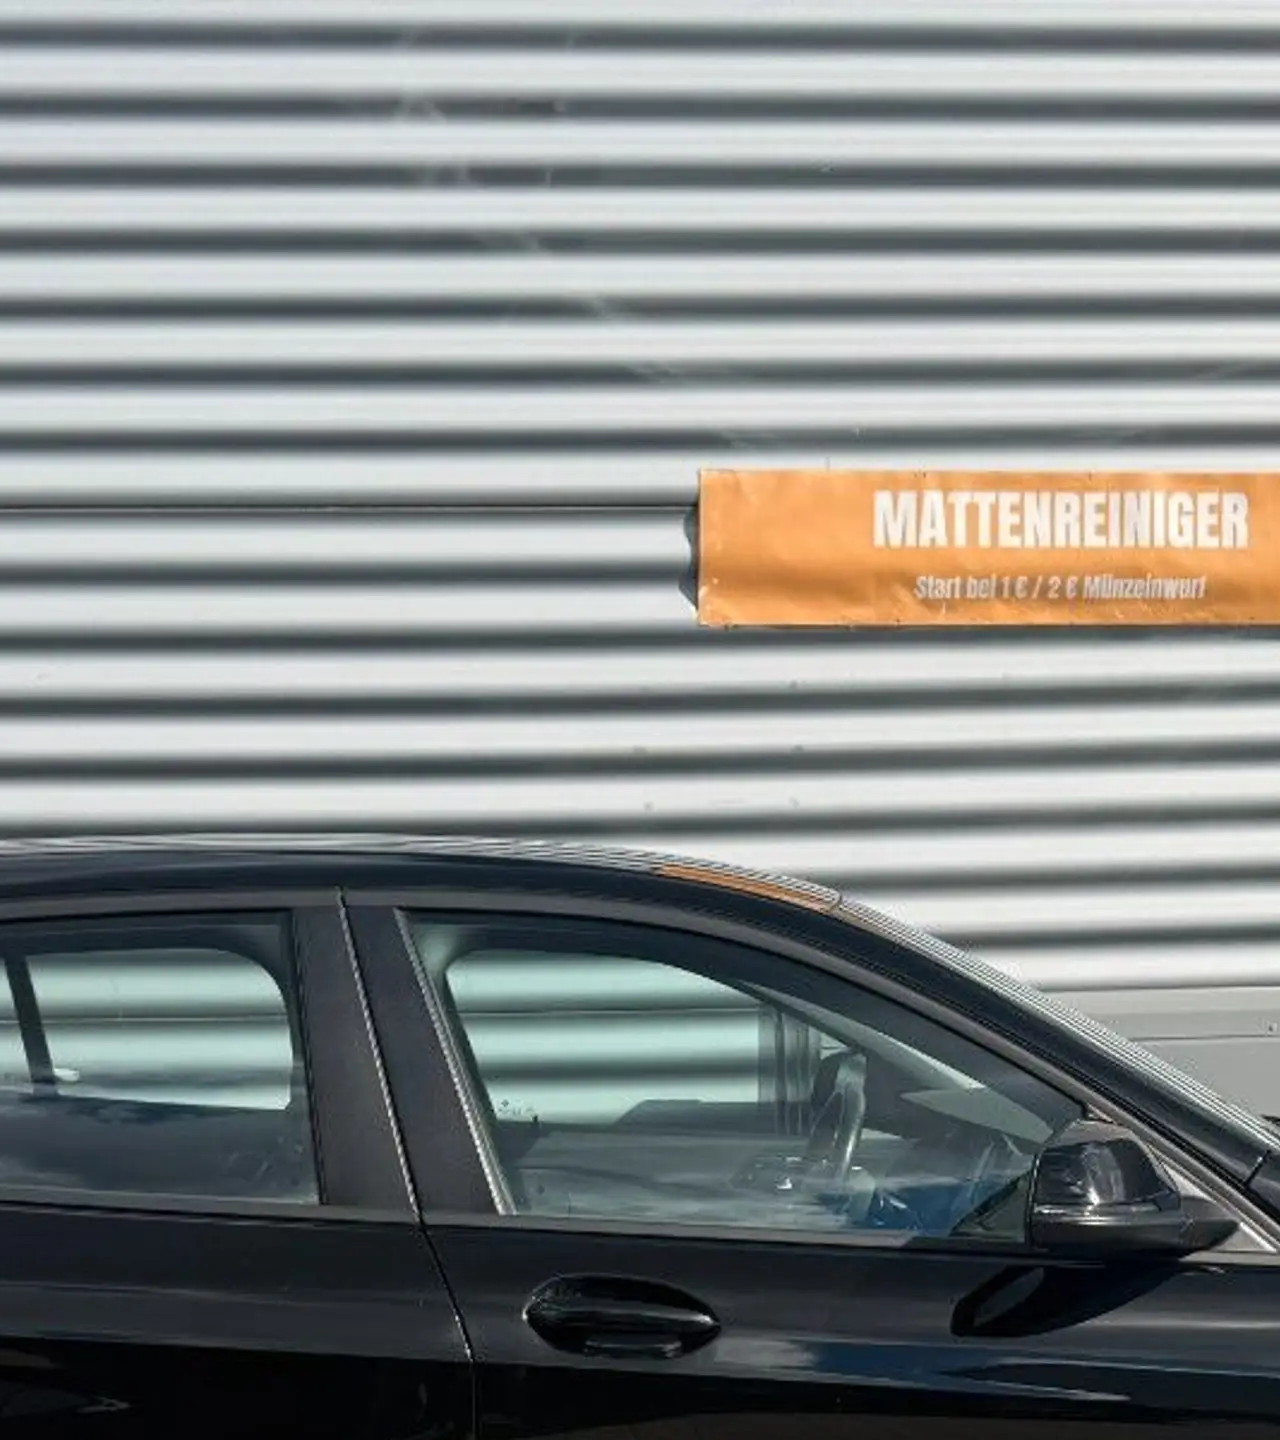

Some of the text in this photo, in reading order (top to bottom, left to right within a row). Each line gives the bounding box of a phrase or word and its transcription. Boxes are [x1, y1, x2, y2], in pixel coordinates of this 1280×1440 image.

[873, 489, 1249, 549] MATTENREINIGER
[914, 576, 961, 599] Start
[966, 575, 996, 599] bei
[1047, 575, 1061, 599] 2
[1065, 576, 1078, 598] €
[1083, 574, 1207, 599] Münzeinwurf
